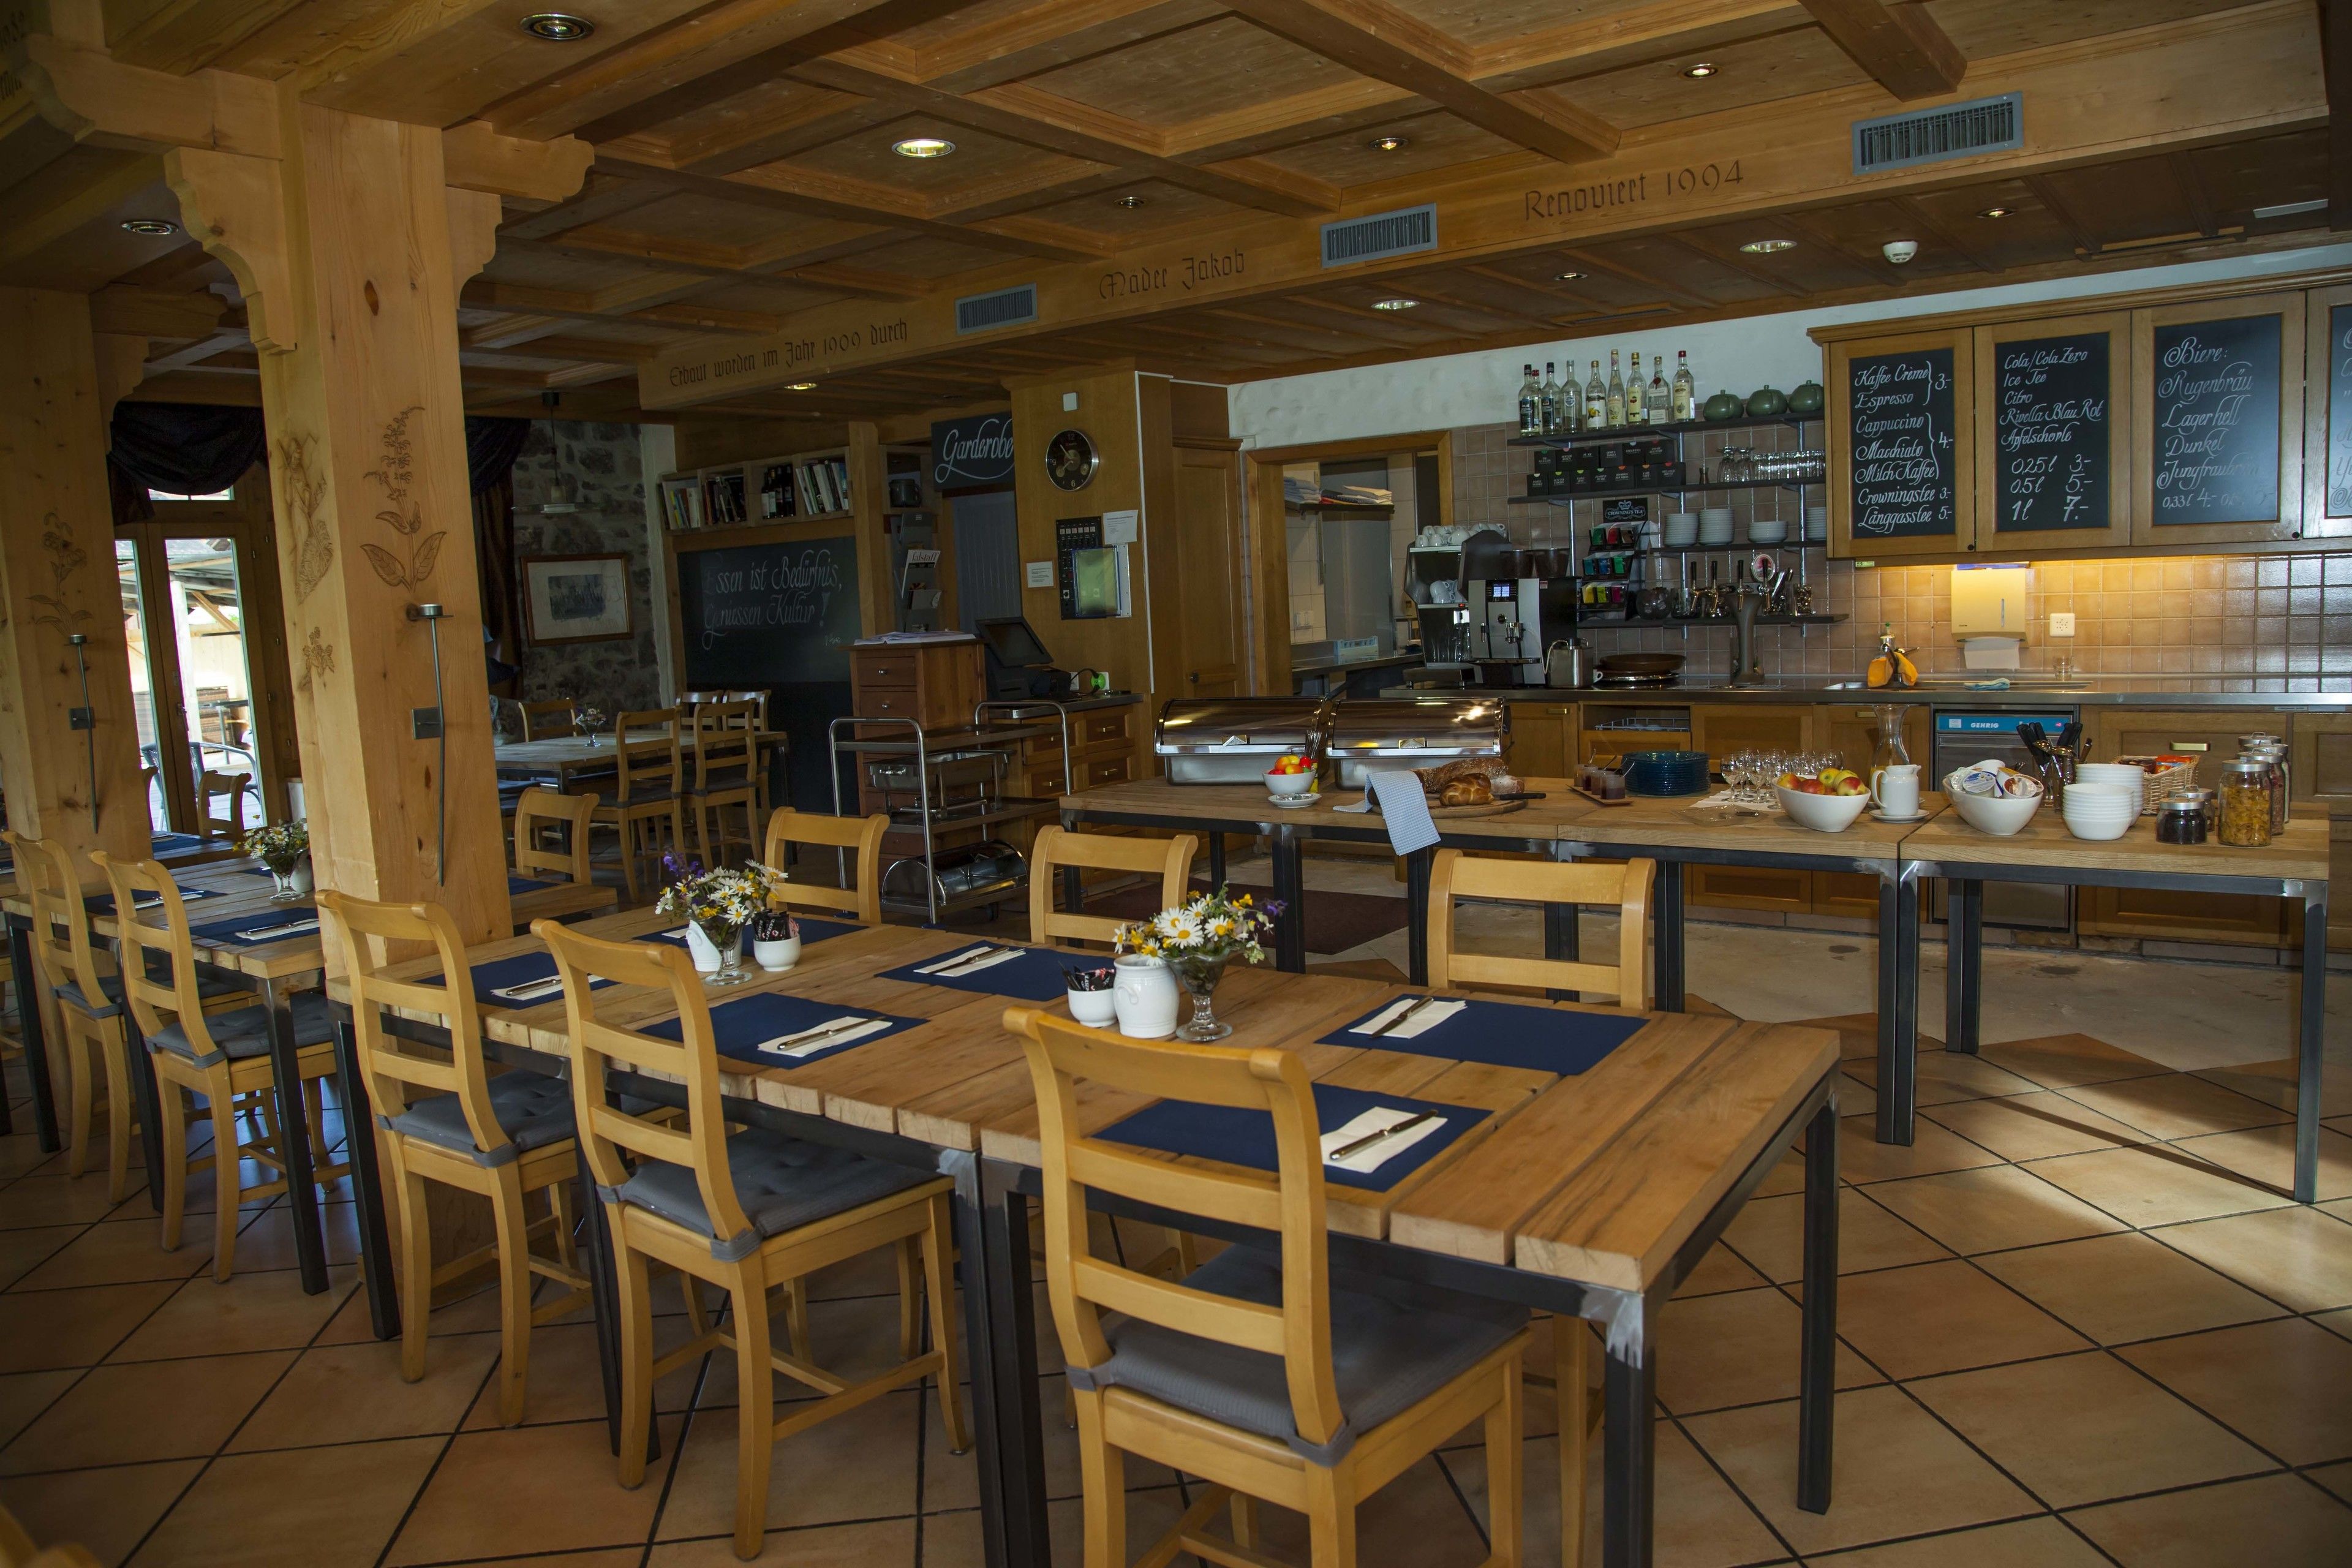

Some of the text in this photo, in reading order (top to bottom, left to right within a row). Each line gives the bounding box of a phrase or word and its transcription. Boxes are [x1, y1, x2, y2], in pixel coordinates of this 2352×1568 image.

[1667, 159, 1744, 197] 1994
[1182, 247, 1244, 290] Jakob
[669, 363, 706, 386] Erbaut
[714, 353, 756, 378] worden
[763, 350, 778, 368] im
[785, 339, 815, 368] Jahr
[870, 318, 907, 346] durch
[2164, 337, 2228, 367] Biere:
[1855, 363, 1929, 390] Kaffee Crème
[2003, 368, 2048, 387] Ice Tee
[2158, 361, 2253, 404] Rugenbräu
[1855, 389, 1914, 413] Espresso
[2005, 390, 2033, 405] Citro
[1856, 413, 1924, 438] Cappuccino
[2000, 399, 2104, 427] Rivella Blau Rot
[1856, 437, 1923, 461] Macchiato
[2001, 421, 2080, 451] Apfelschorle
[2166, 428, 2229, 456] Dunkel
[935, 418, 1014, 483] Garderobe
[1858, 483, 1936, 506] Crowningstee
[1858, 505, 1932, 533] Länggasstee
[912, 551, 939, 561] falstaff
[750, 560, 767, 591] ist
[772, 549, 842, 595] Bedürfnis,
